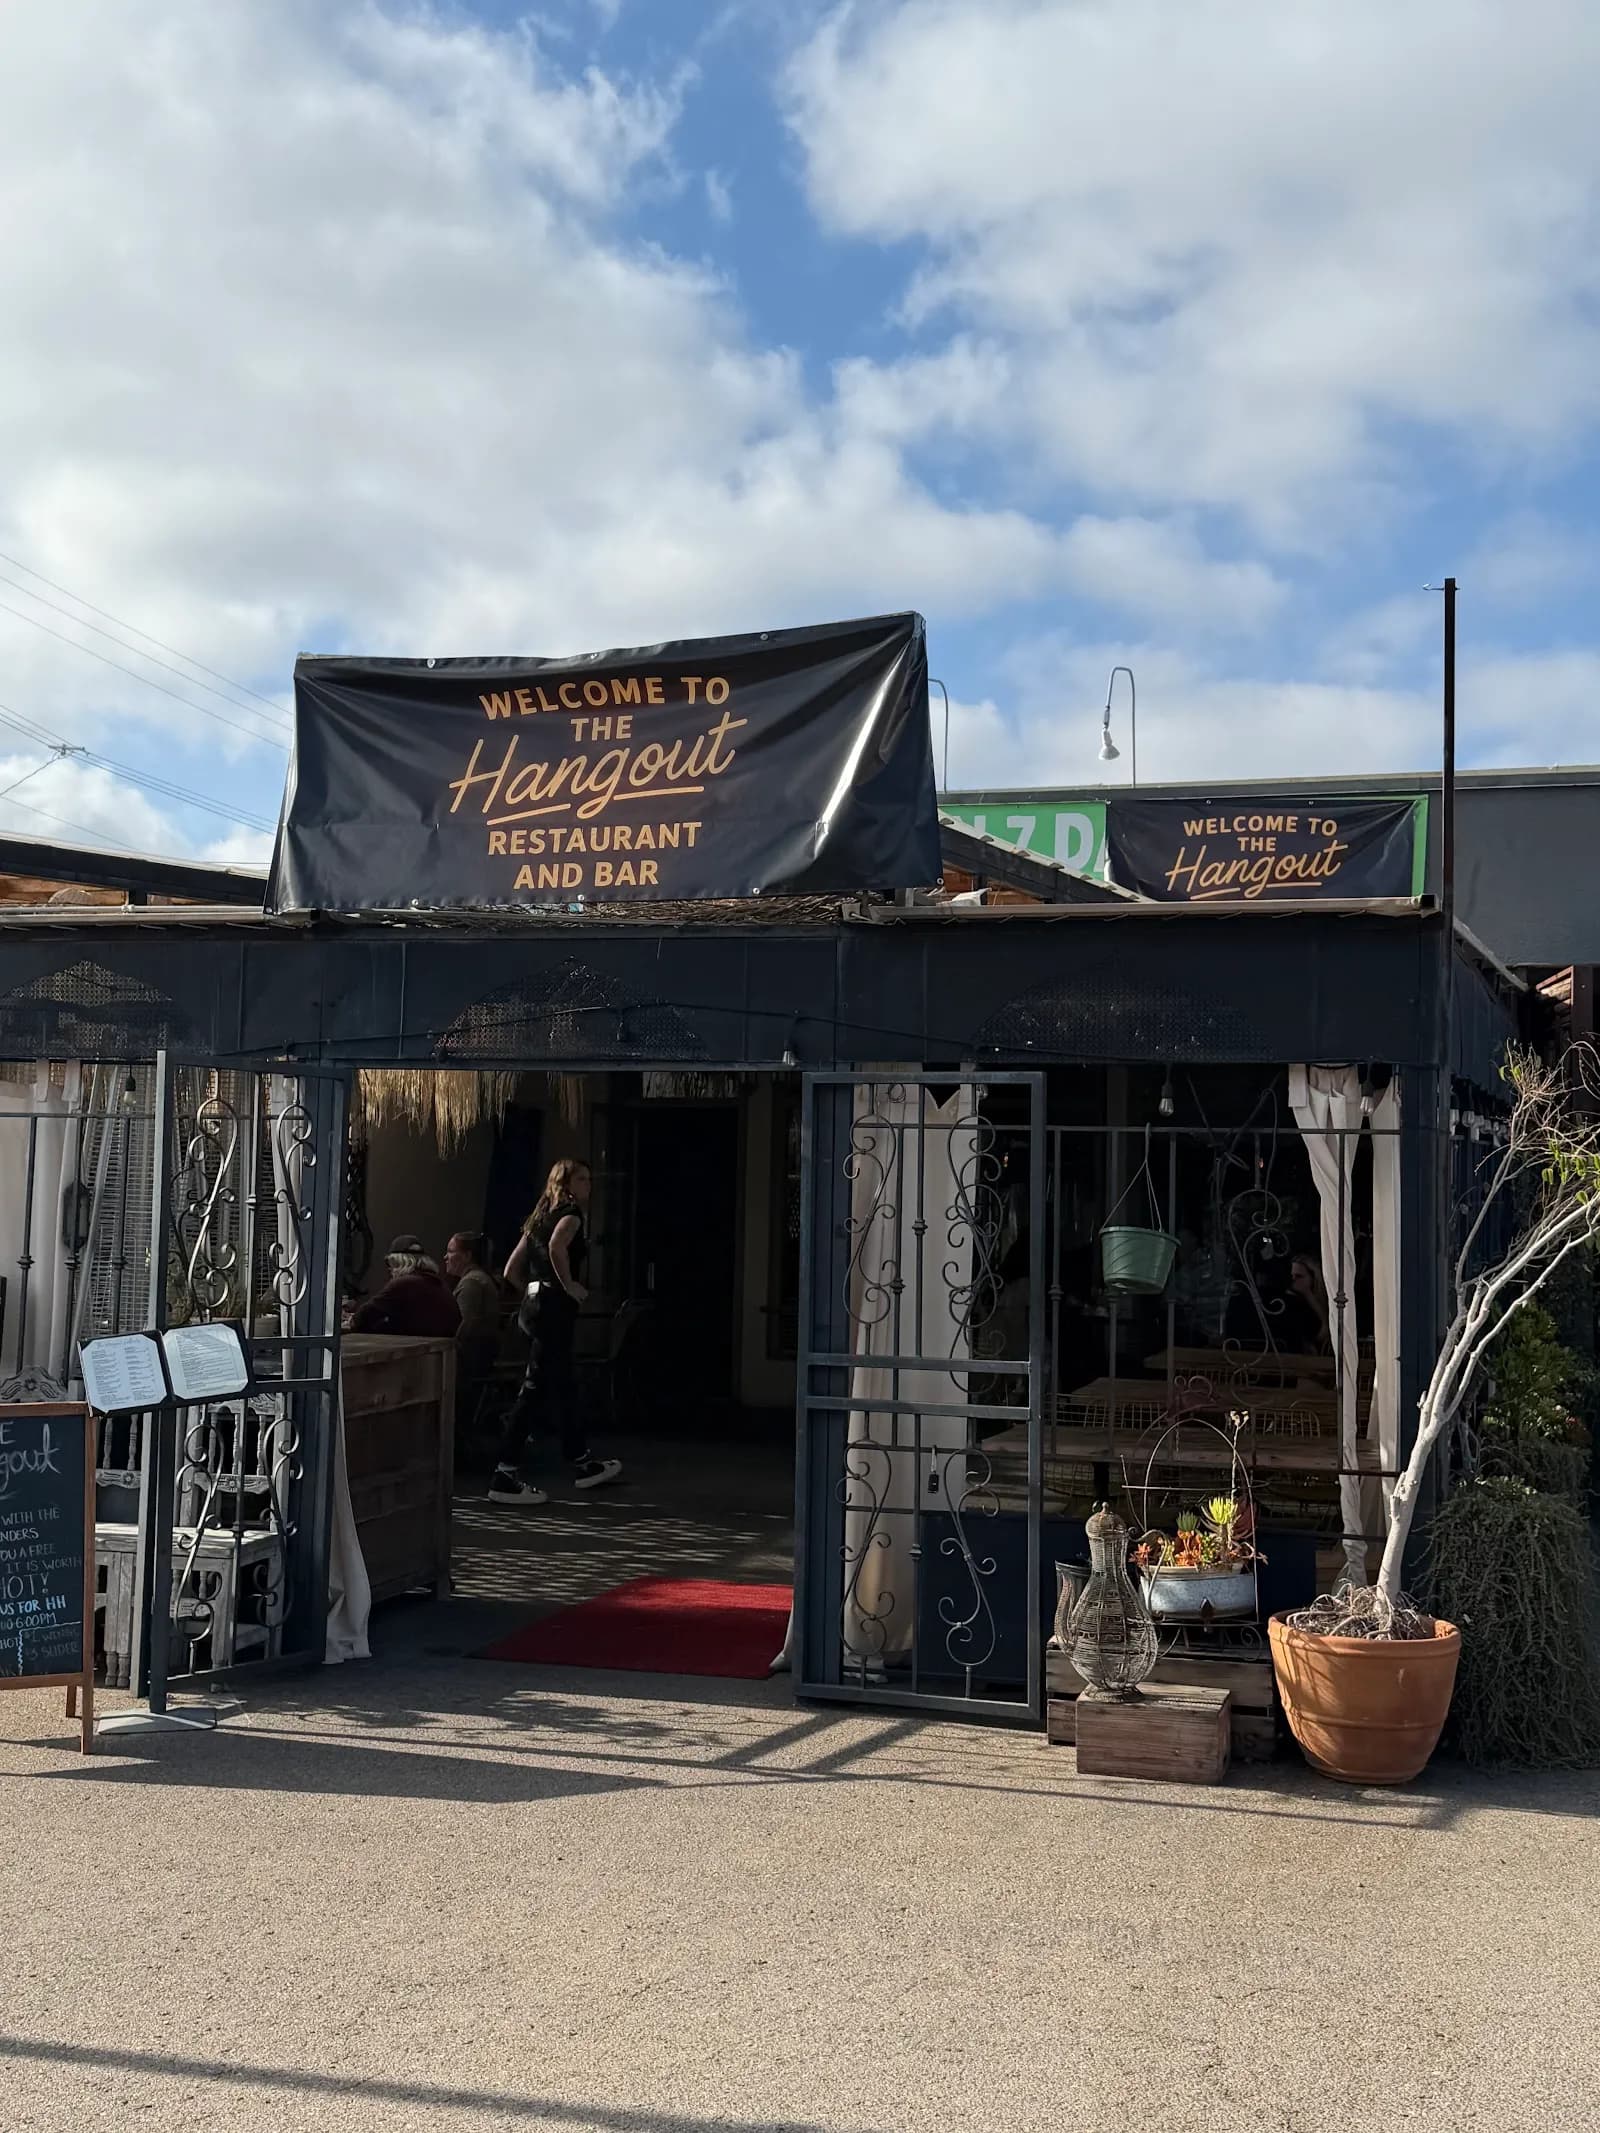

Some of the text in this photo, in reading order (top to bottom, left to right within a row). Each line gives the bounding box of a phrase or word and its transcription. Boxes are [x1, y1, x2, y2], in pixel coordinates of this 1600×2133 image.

[479, 676, 730, 720] WELCOME TO
[571, 715, 633, 741] THE
[449, 711, 748, 820] Hangout
[487, 822, 702, 855] RESTAURANT
[1183, 815, 1337, 836] WELCOME TO
[1237, 837, 1277, 851] THE
[513, 860, 659, 889] AND BAR
[1165, 840, 1348, 898] Hangout
[1, 1506, 62, 1527] WITH THE
[17, 1599, 41, 1614] FOR
[45, 1595, 66, 1610] HH
